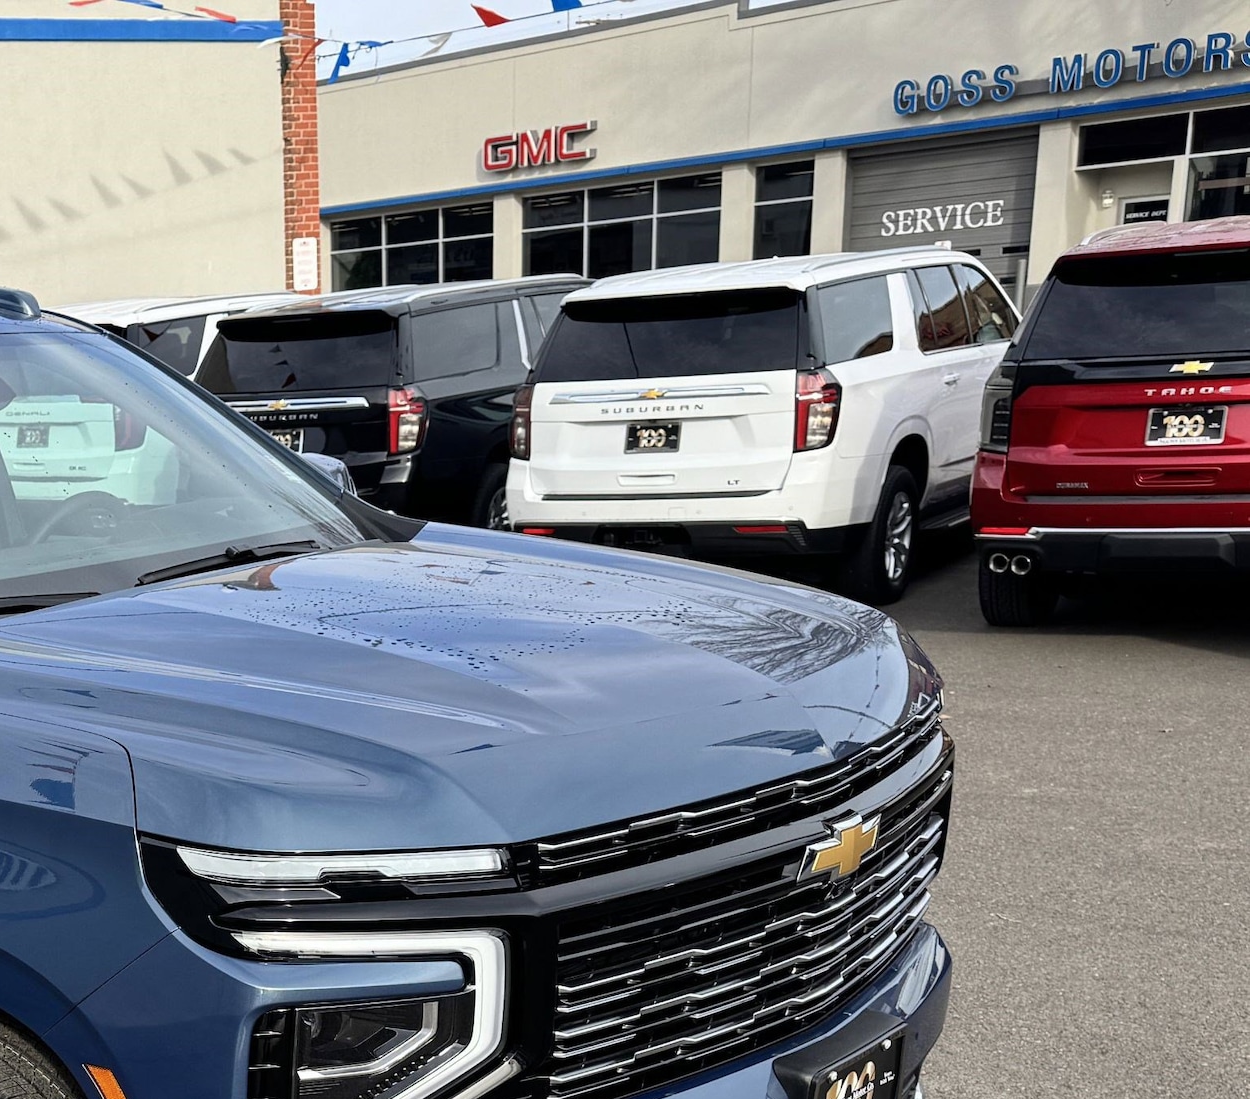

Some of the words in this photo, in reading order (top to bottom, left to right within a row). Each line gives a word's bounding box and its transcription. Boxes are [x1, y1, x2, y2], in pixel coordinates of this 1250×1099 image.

[893, 64, 1018, 116] GOSS
[483, 120, 597, 172] GMC
[880, 199, 1004, 237] SERVICE
[1144, 386, 1233, 396] TAHOE
[250, 413, 319, 422] UBURBAN
[601, 404, 704, 415] SUBURBAN
